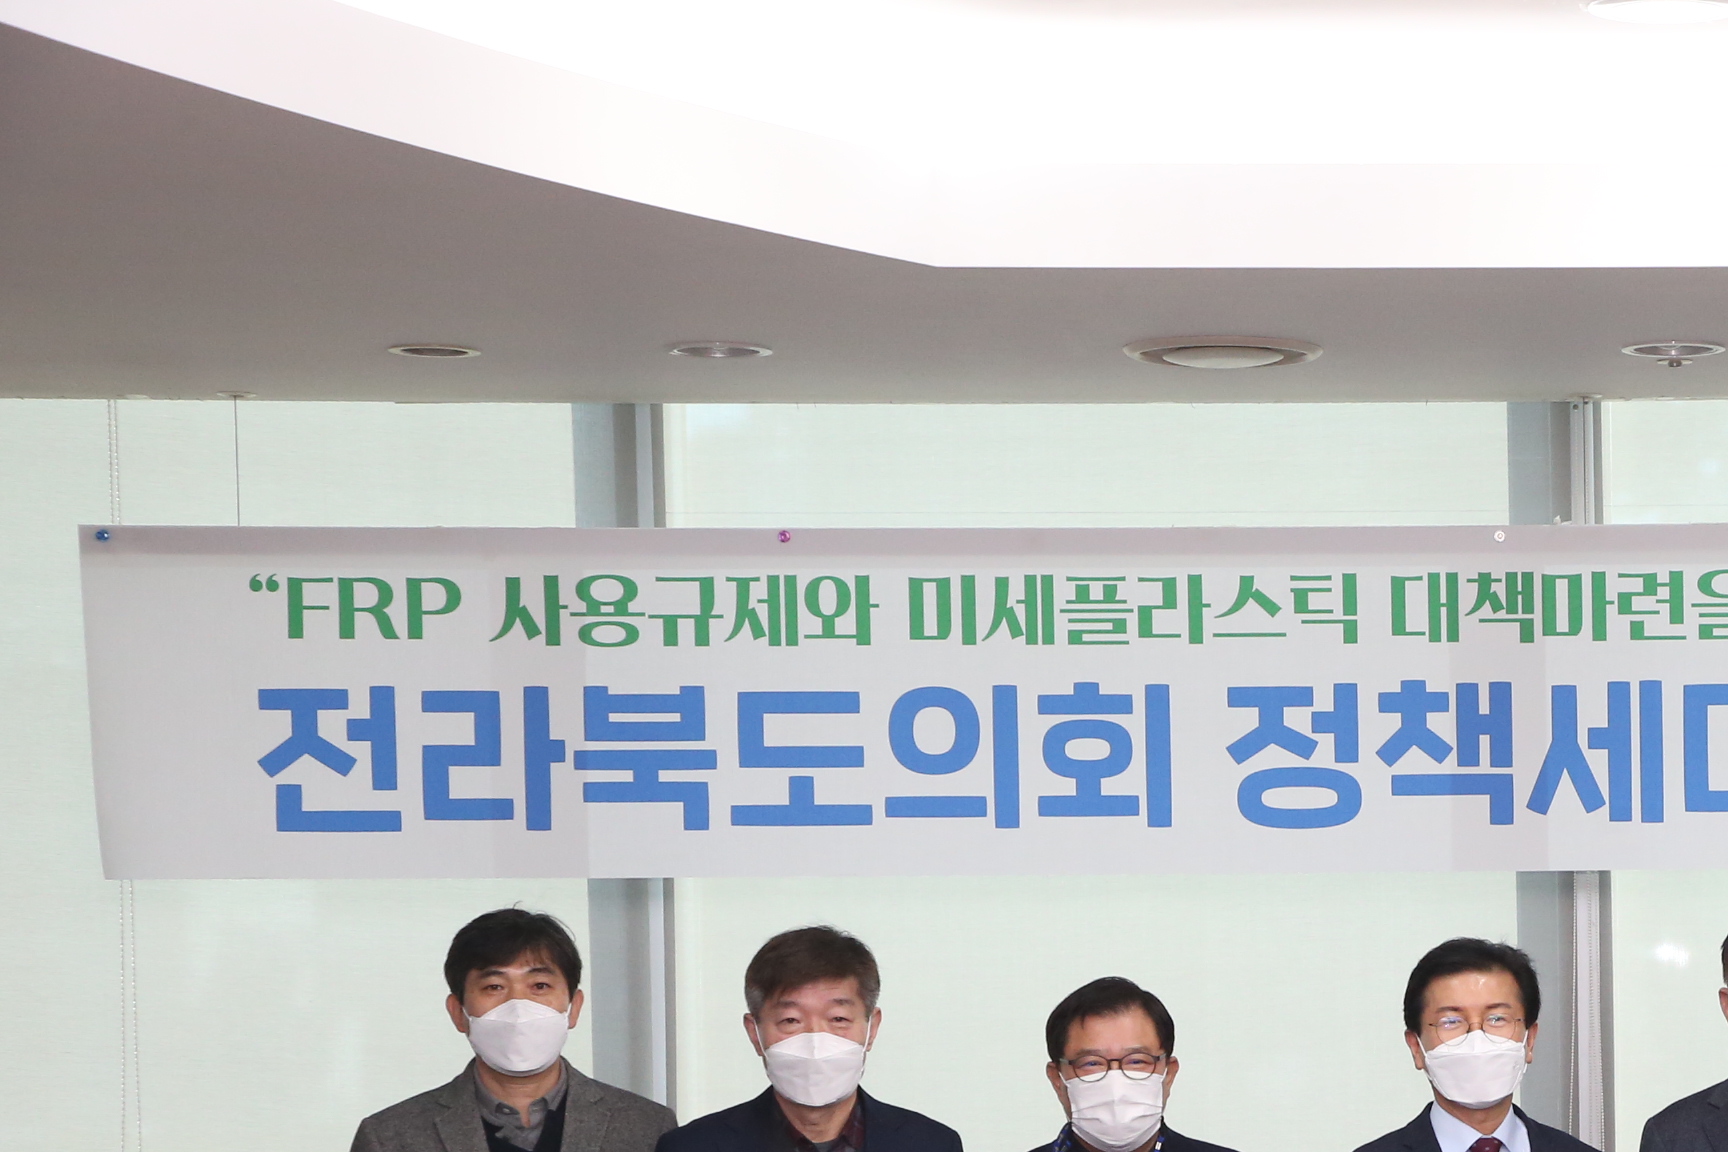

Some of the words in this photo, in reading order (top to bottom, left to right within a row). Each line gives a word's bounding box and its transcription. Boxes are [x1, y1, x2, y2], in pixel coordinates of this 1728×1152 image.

[490, 573, 880, 647] 사용규제와
[909, 572, 1358, 645] 미세플라스틱
[257, 681, 1172, 833] 전라북도의회
